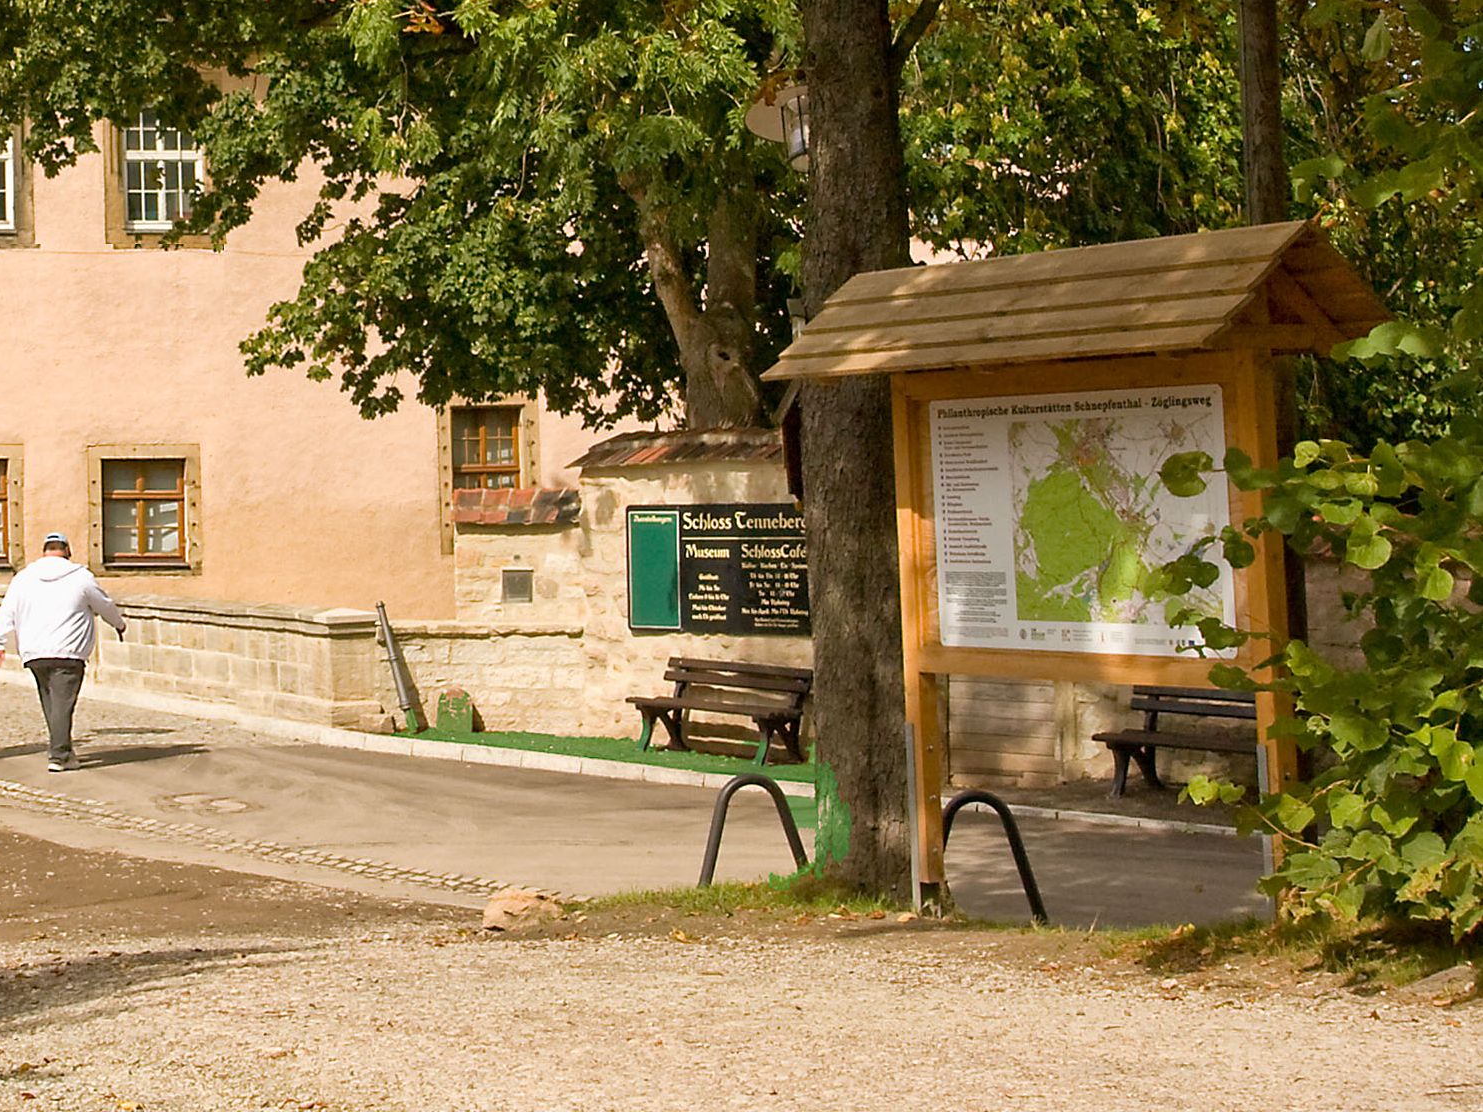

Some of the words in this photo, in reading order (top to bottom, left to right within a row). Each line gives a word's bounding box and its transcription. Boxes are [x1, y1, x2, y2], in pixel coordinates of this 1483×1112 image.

[937, 406, 1009, 419] Philanthropische
[1011, 402, 1072, 415] Kulturstätten
[1074, 397, 1142, 412] Schnepfenthal
[1151, 395, 1212, 409] Zöglingsweg
[682, 511, 732, 531] Schloss
[685, 543, 731, 559] Museum
